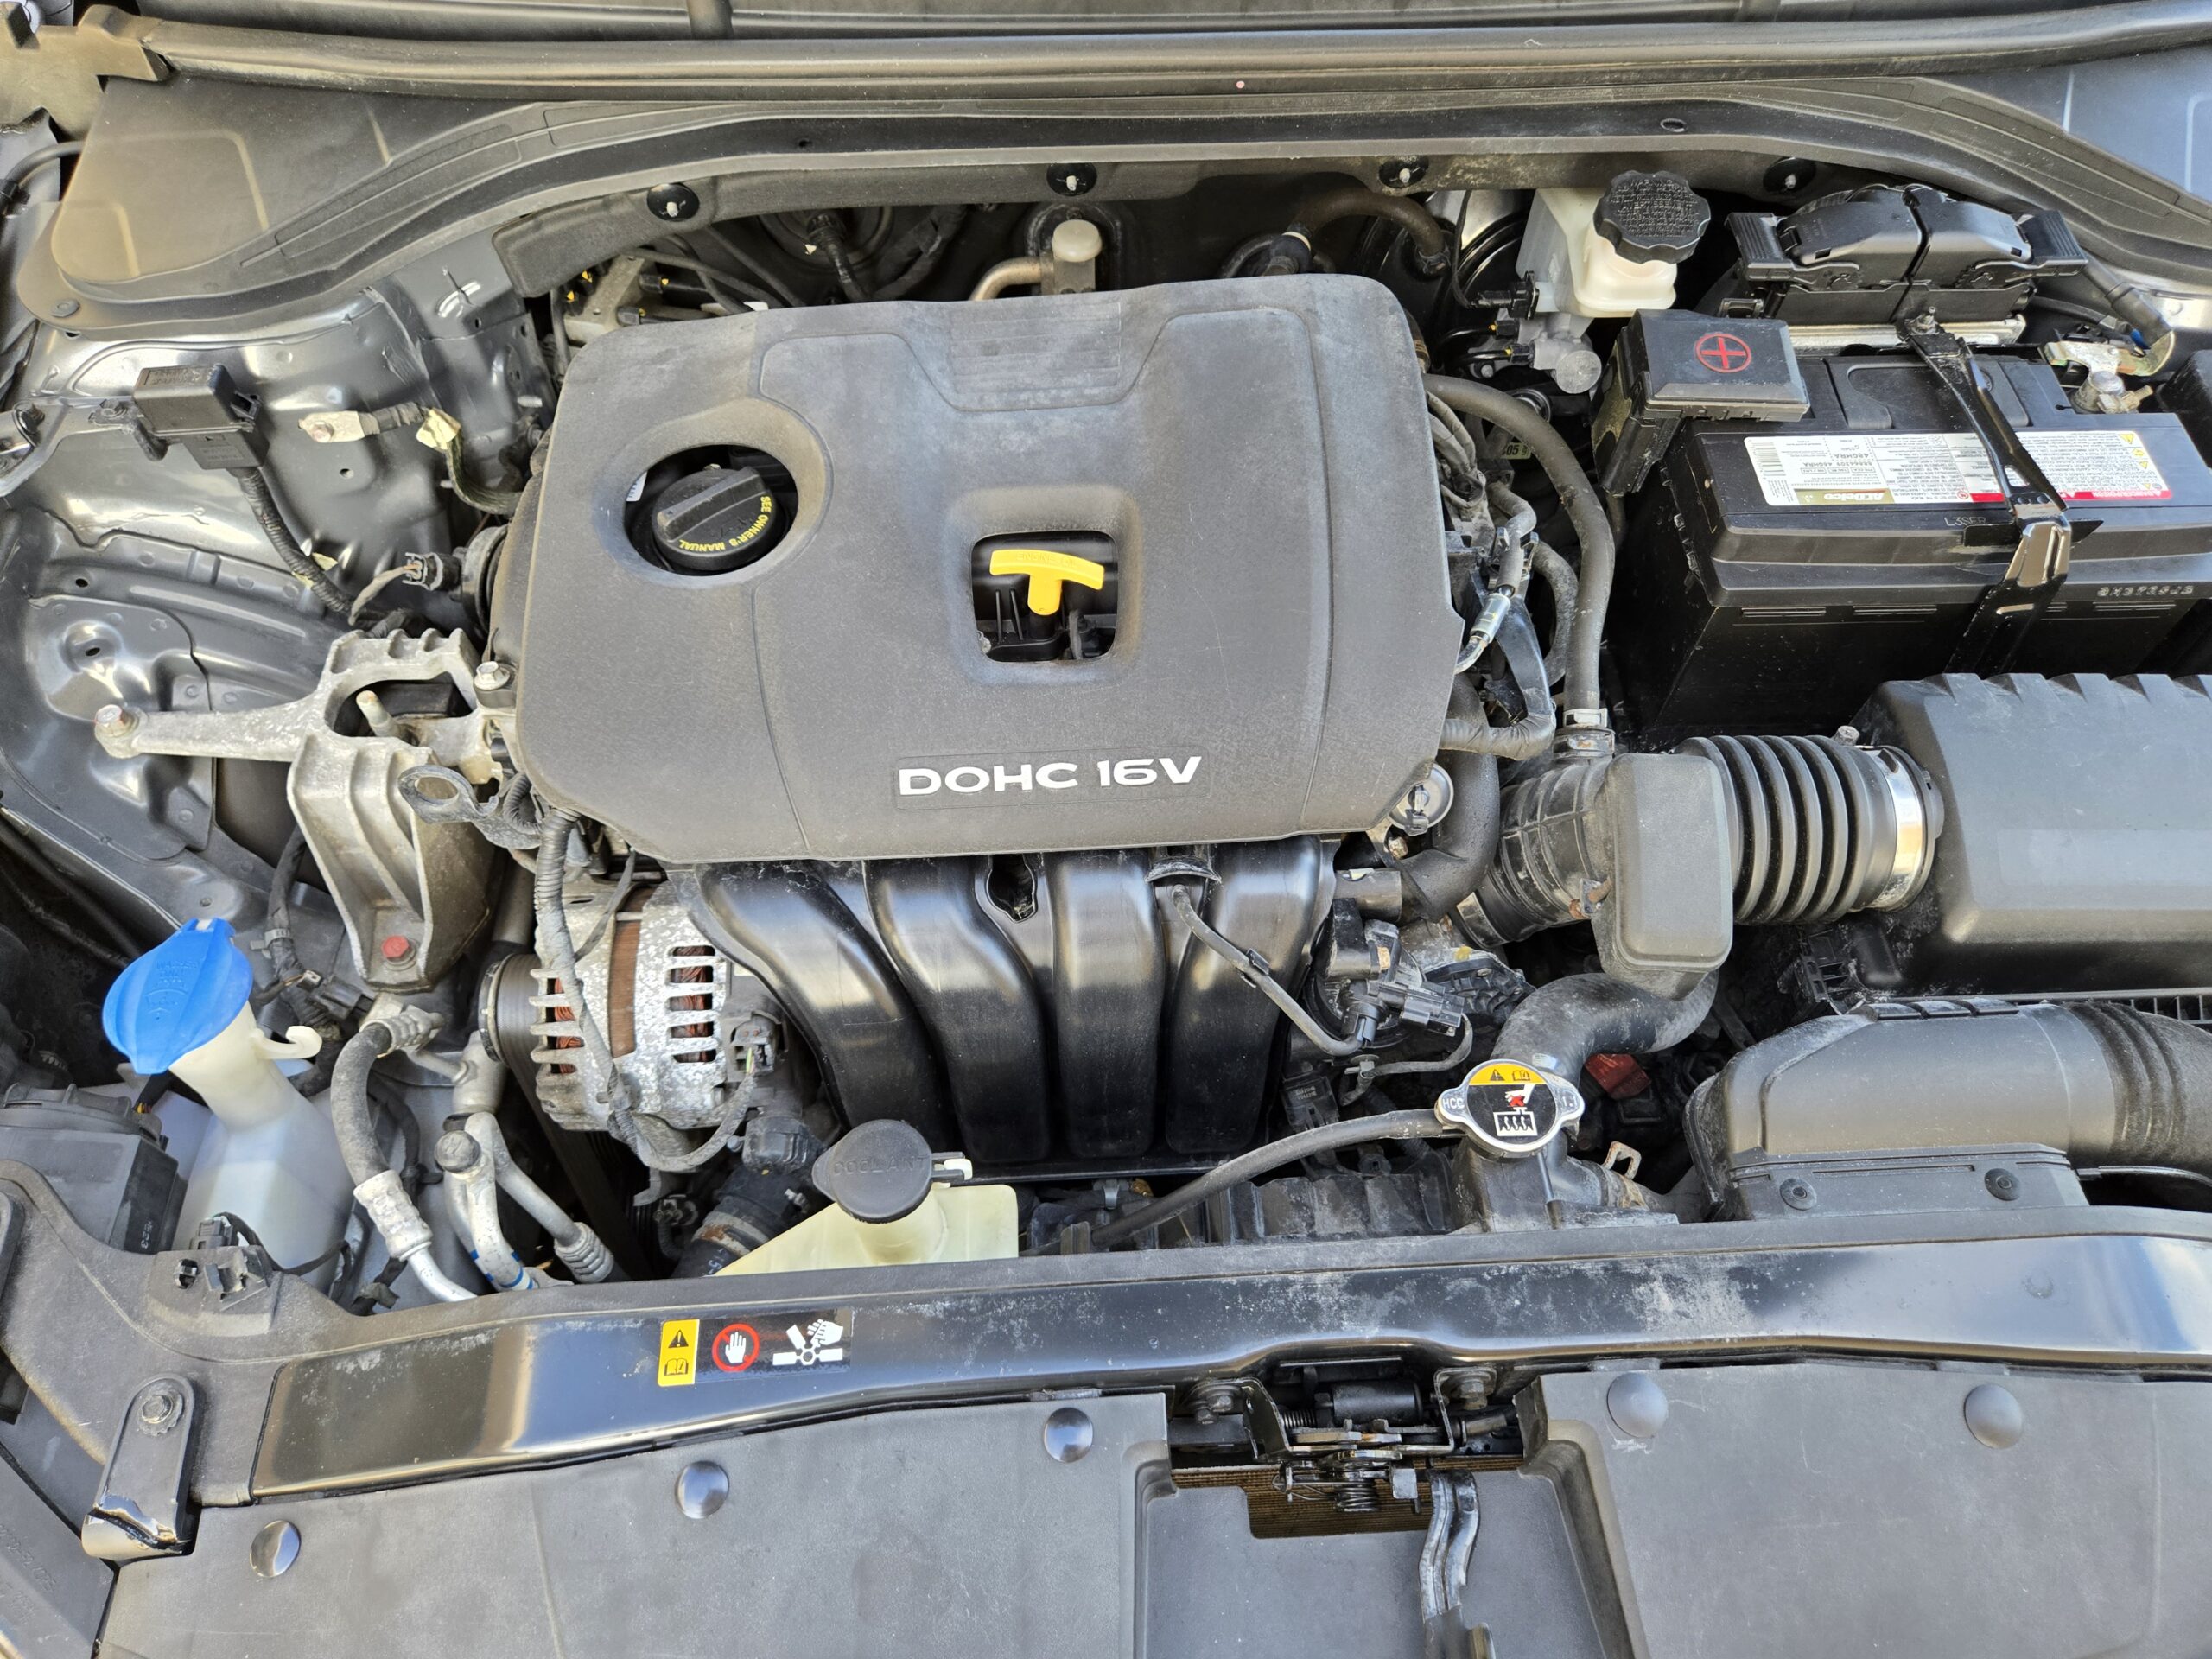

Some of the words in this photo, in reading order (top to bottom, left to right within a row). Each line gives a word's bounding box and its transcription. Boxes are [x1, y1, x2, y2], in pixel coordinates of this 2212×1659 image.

[760, 496, 772, 512] SEE
[1823, 493, 1885, 502] ACDelco
[728, 514, 768, 547] OWNER'S
[678, 539, 726, 552] MANUAL
[899, 762, 1079, 796] DOHC
[1097, 756, 1202, 787] 16V
[1443, 1097, 1465, 1109] HCC
[833, 1154, 931, 1176] COOLANT
